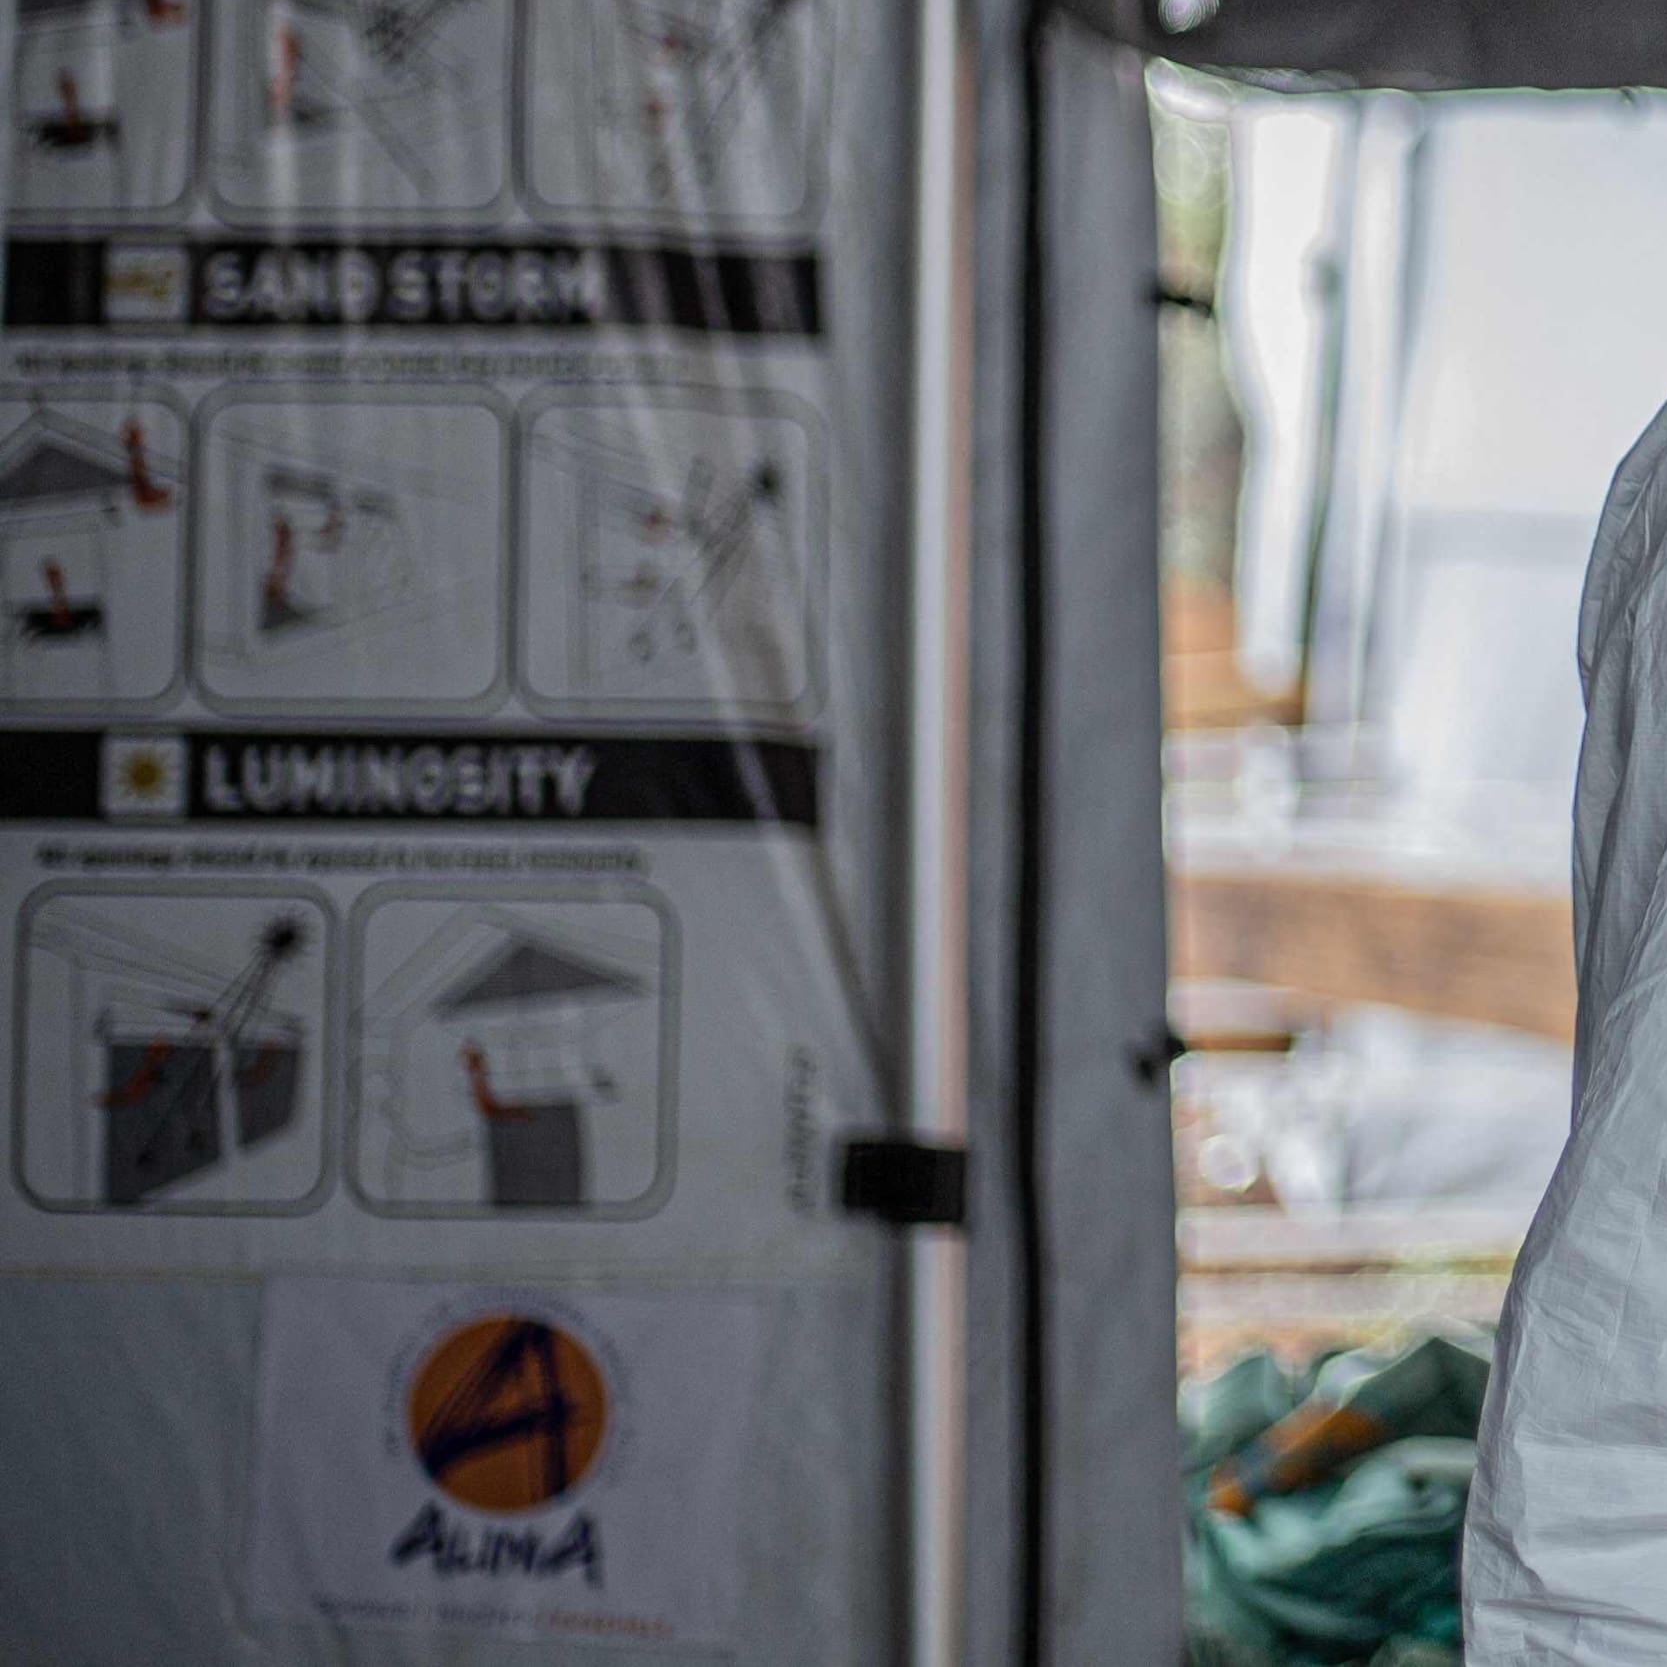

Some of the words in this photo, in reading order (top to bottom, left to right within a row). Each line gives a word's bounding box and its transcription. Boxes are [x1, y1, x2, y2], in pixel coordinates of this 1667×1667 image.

[202, 248, 376, 323] SAND
[384, 246, 605, 322] STORM
[203, 741, 600, 818] LUMINOSITY
[392, 1502, 603, 1586] ALIMA
